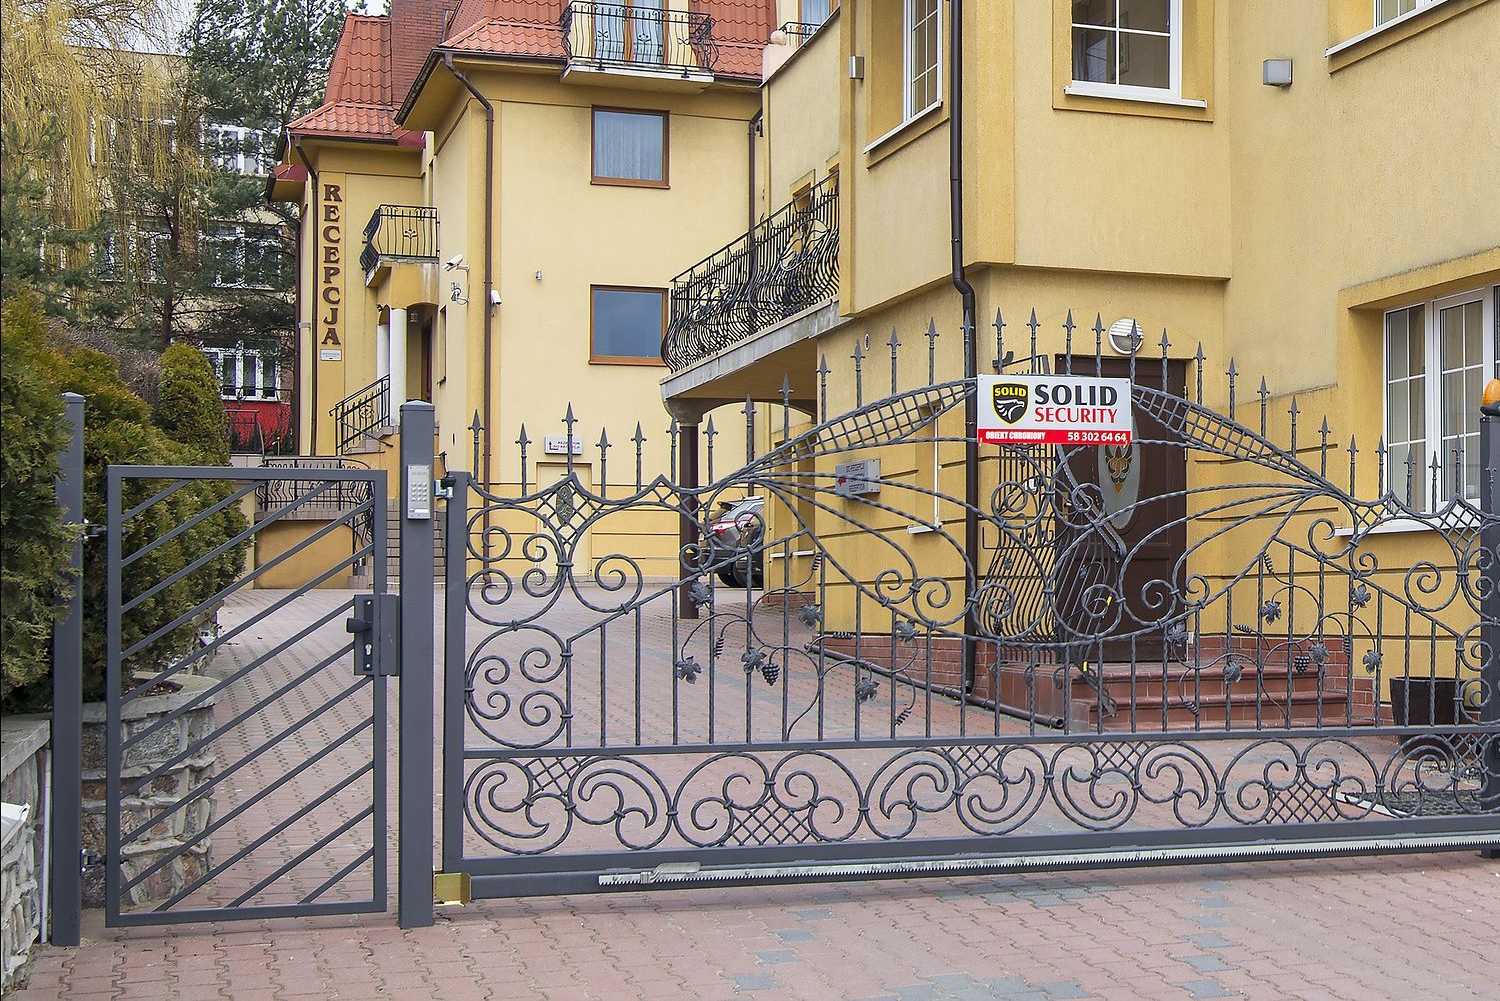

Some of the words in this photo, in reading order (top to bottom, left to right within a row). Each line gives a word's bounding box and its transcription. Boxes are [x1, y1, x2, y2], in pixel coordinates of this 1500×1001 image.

[321, 183, 343, 346] RECEPCJA
[994, 386, 1027, 397] SOLID
[1034, 384, 1118, 407] SOLID
[1034, 406, 1118, 424] SECURITY
[1067, 432, 1080, 441] 58
[1081, 432, 1100, 441] 302
[1101, 432, 1113, 442] 64
[1114, 432, 1127, 442] 64
